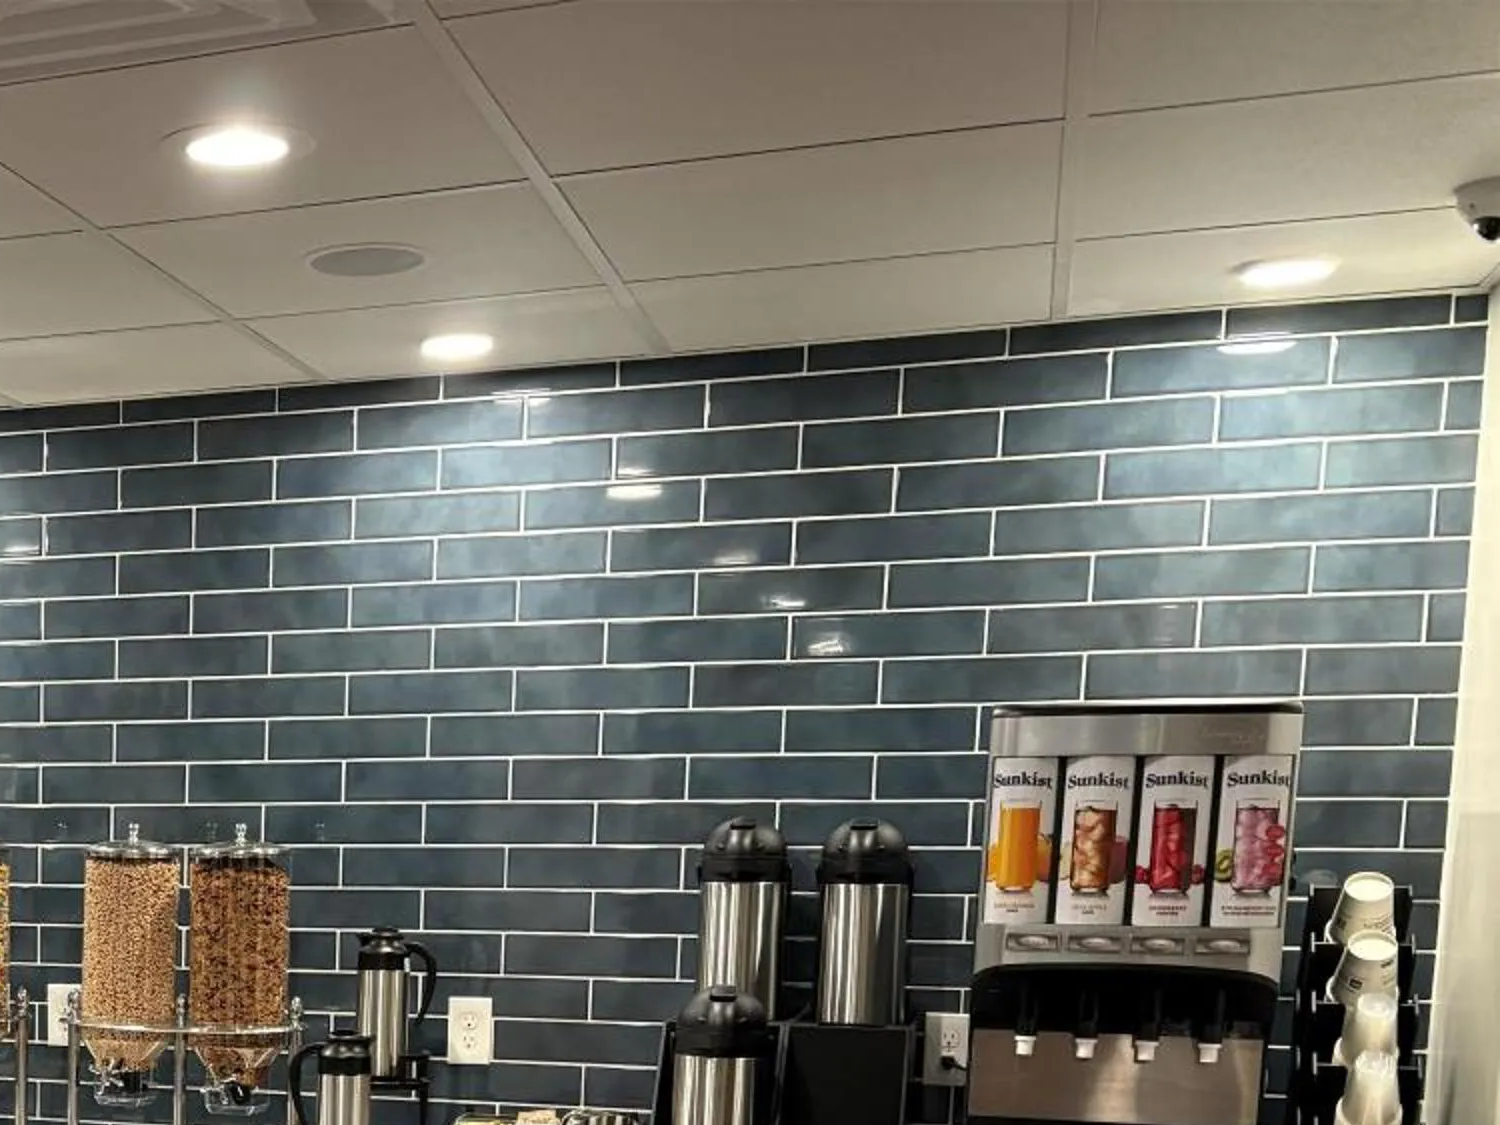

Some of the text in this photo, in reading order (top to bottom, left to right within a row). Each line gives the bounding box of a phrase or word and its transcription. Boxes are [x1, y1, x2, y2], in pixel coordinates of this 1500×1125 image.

[994, 771, 1052, 790] Sunkist
[1068, 771, 1130, 790] Sunkist
[1145, 771, 1209, 789] Sunkist
